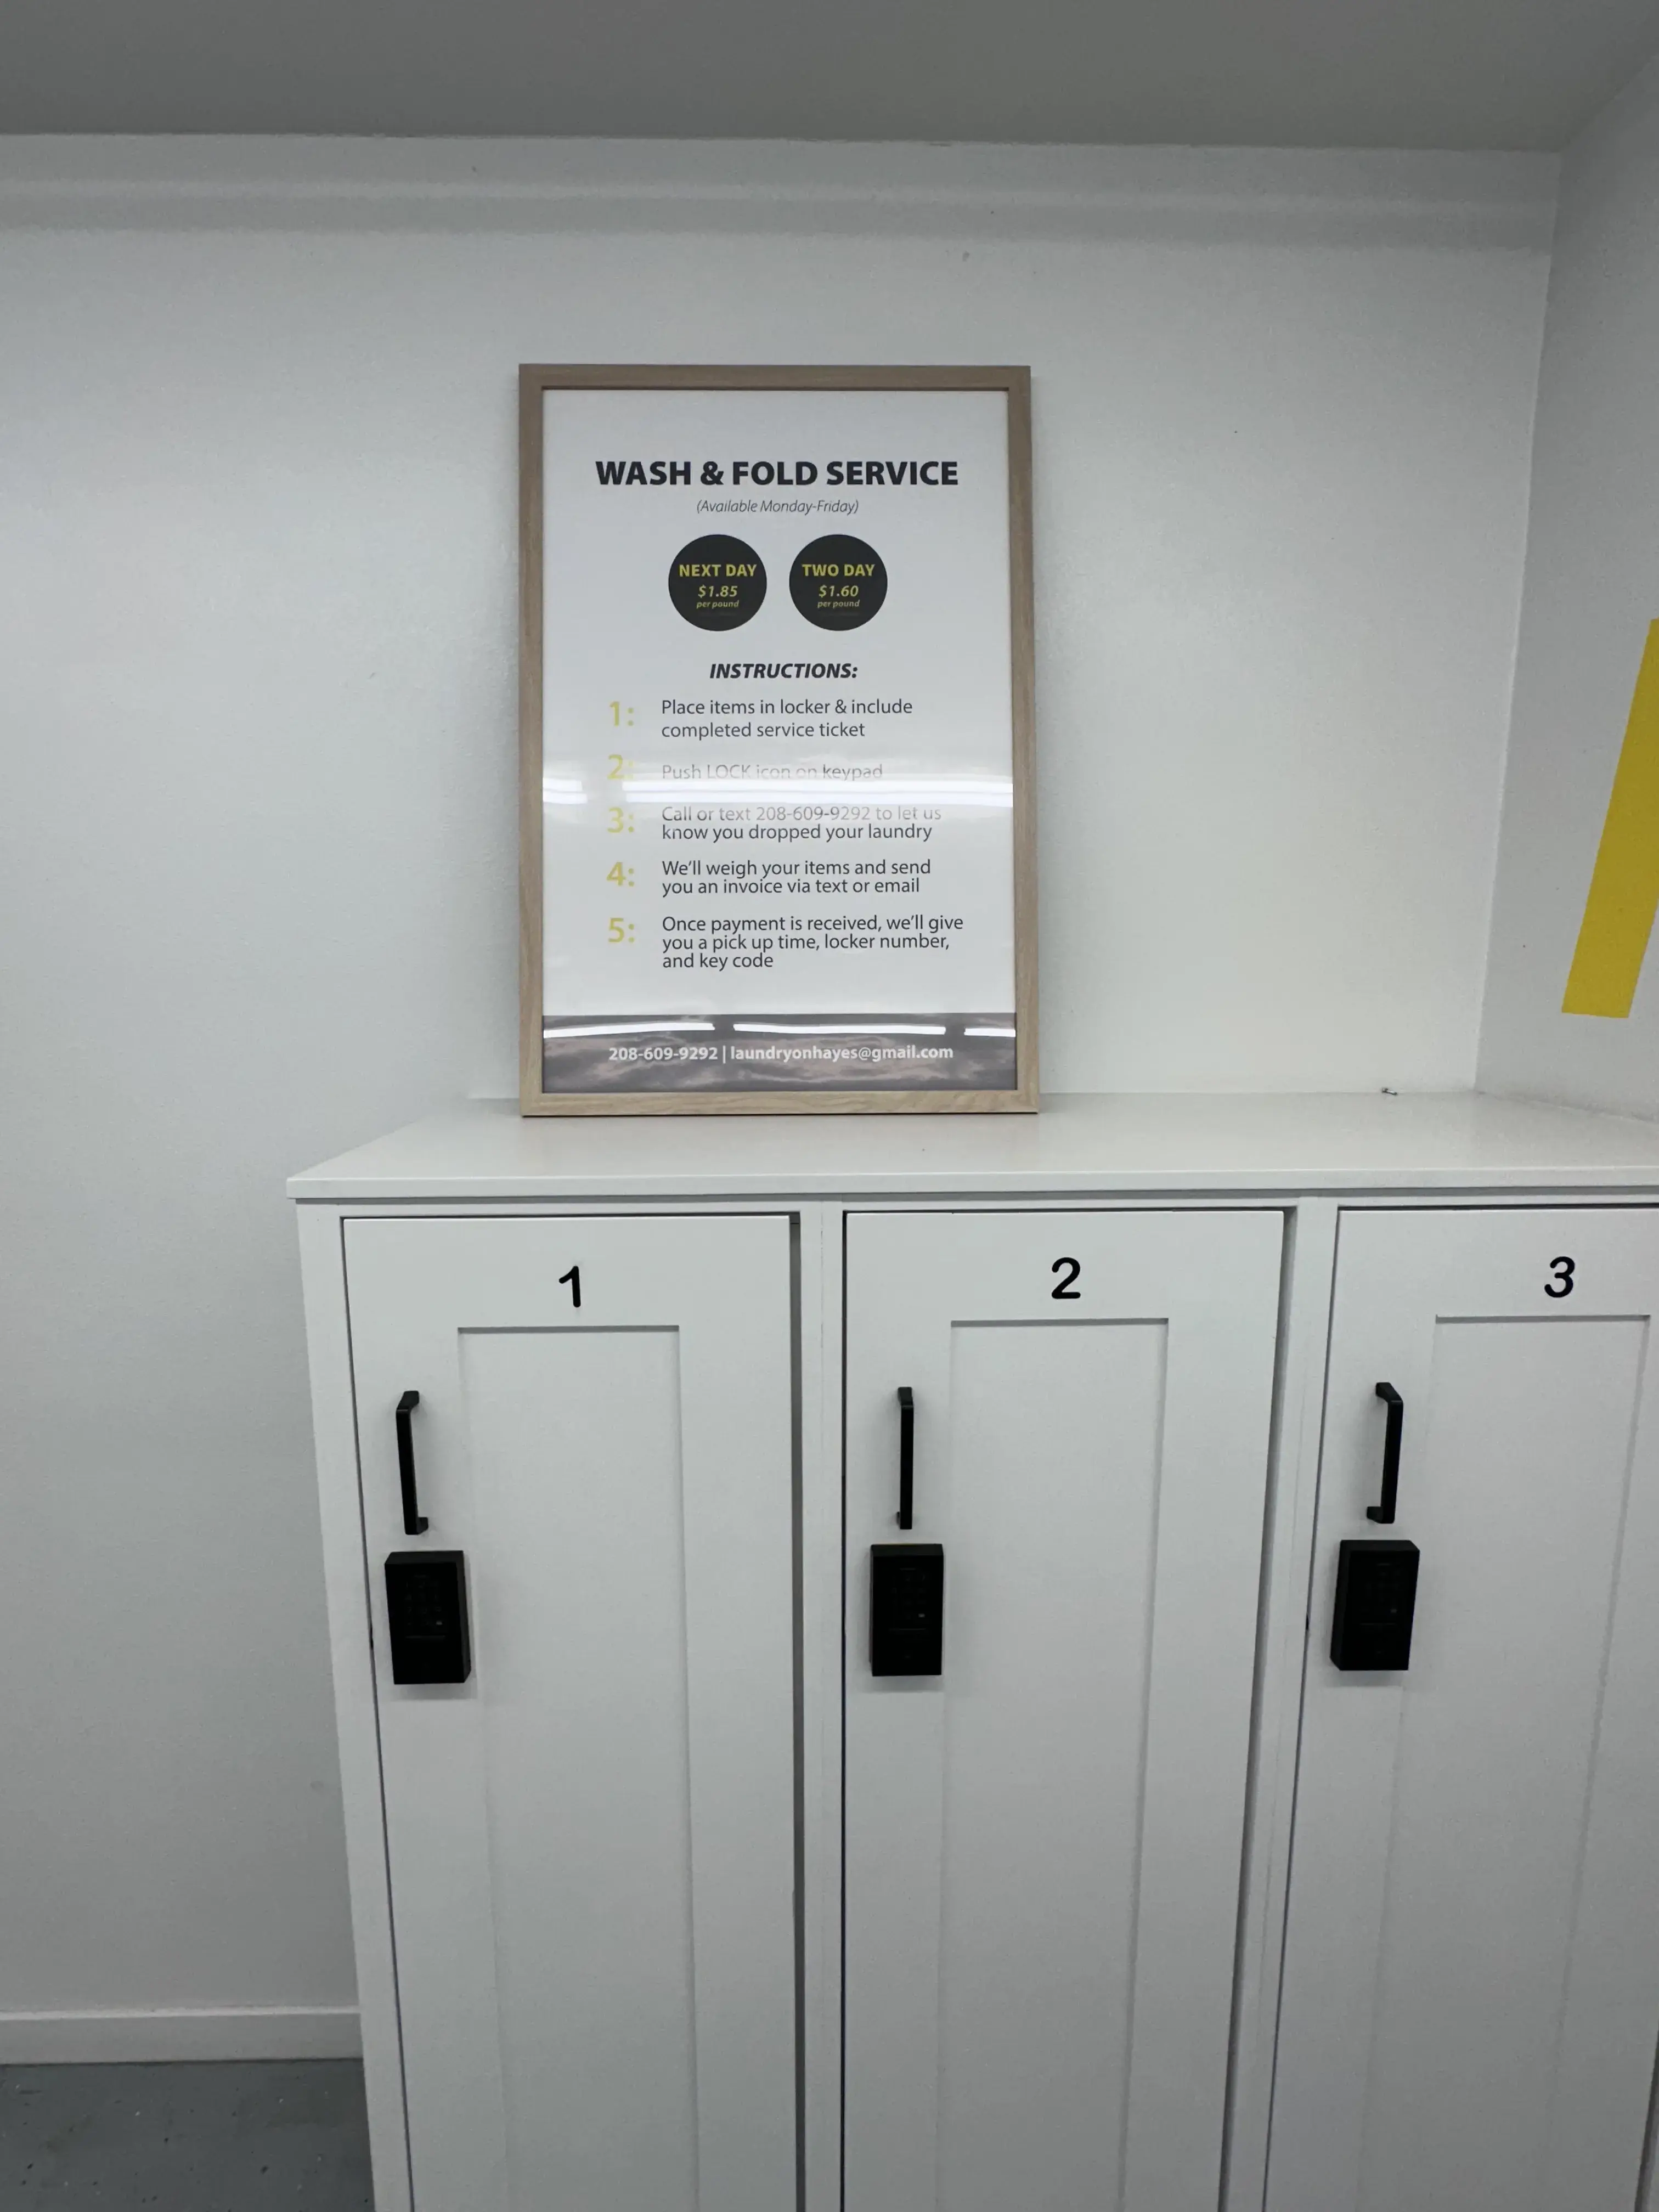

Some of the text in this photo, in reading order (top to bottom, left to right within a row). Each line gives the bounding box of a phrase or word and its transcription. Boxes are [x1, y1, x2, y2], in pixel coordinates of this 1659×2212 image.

[596, 461, 958, 485] WASH & FOLD SERVICE
[697, 499, 858, 515] (Available Monday-Friday)
[680, 565, 757, 577] NEXT DAY
[802, 565, 874, 576] TWO DAY
[698, 585, 737, 598] $1.85
[819, 585, 858, 597] $1.60
[712, 600, 740, 609] pound
[833, 600, 860, 609] pound
[710, 663, 857, 678] INSTRUCTIONS:
[609, 702, 634, 727] 1:
[663, 699, 912, 714] Place items in locker & include
[662, 722, 865, 741] completed service ticket
[662, 764, 882, 780] Push LOCK icon on keypad
[608, 808, 634, 833] 3:
[662, 806, 941, 821] Call or text 208-609-9292 to let us
[663, 823, 932, 843] know you dropped your laundry
[606, 862, 635, 887] 4:
[707, 860, 757, 878] weigh
[762, 864, 799, 878] your
[805, 861, 849, 874] items
[855, 860, 885, 874] and
[892, 859, 930, 874] send
[663, 878, 918, 898] you an invoice via text or email
[609, 918, 635, 944] 5:
[663, 917, 706, 931] Once
[712, 917, 785, 934] payment
[791, 916, 802, 930] is
[808, 915, 881, 932] received,
[929, 915, 963, 934] give
[663, 933, 949, 953] you a pick up time, locker number,
[663, 952, 773, 971] and key code
[609, 1047, 717, 1060] 208-609-9292
[731, 1045, 953, 1063] laundryonhayes@gmail.com
[1052, 1257, 1081, 1299] 2
[1544, 1256, 1575, 1297] 3
[559, 1266, 581, 1307] 1
